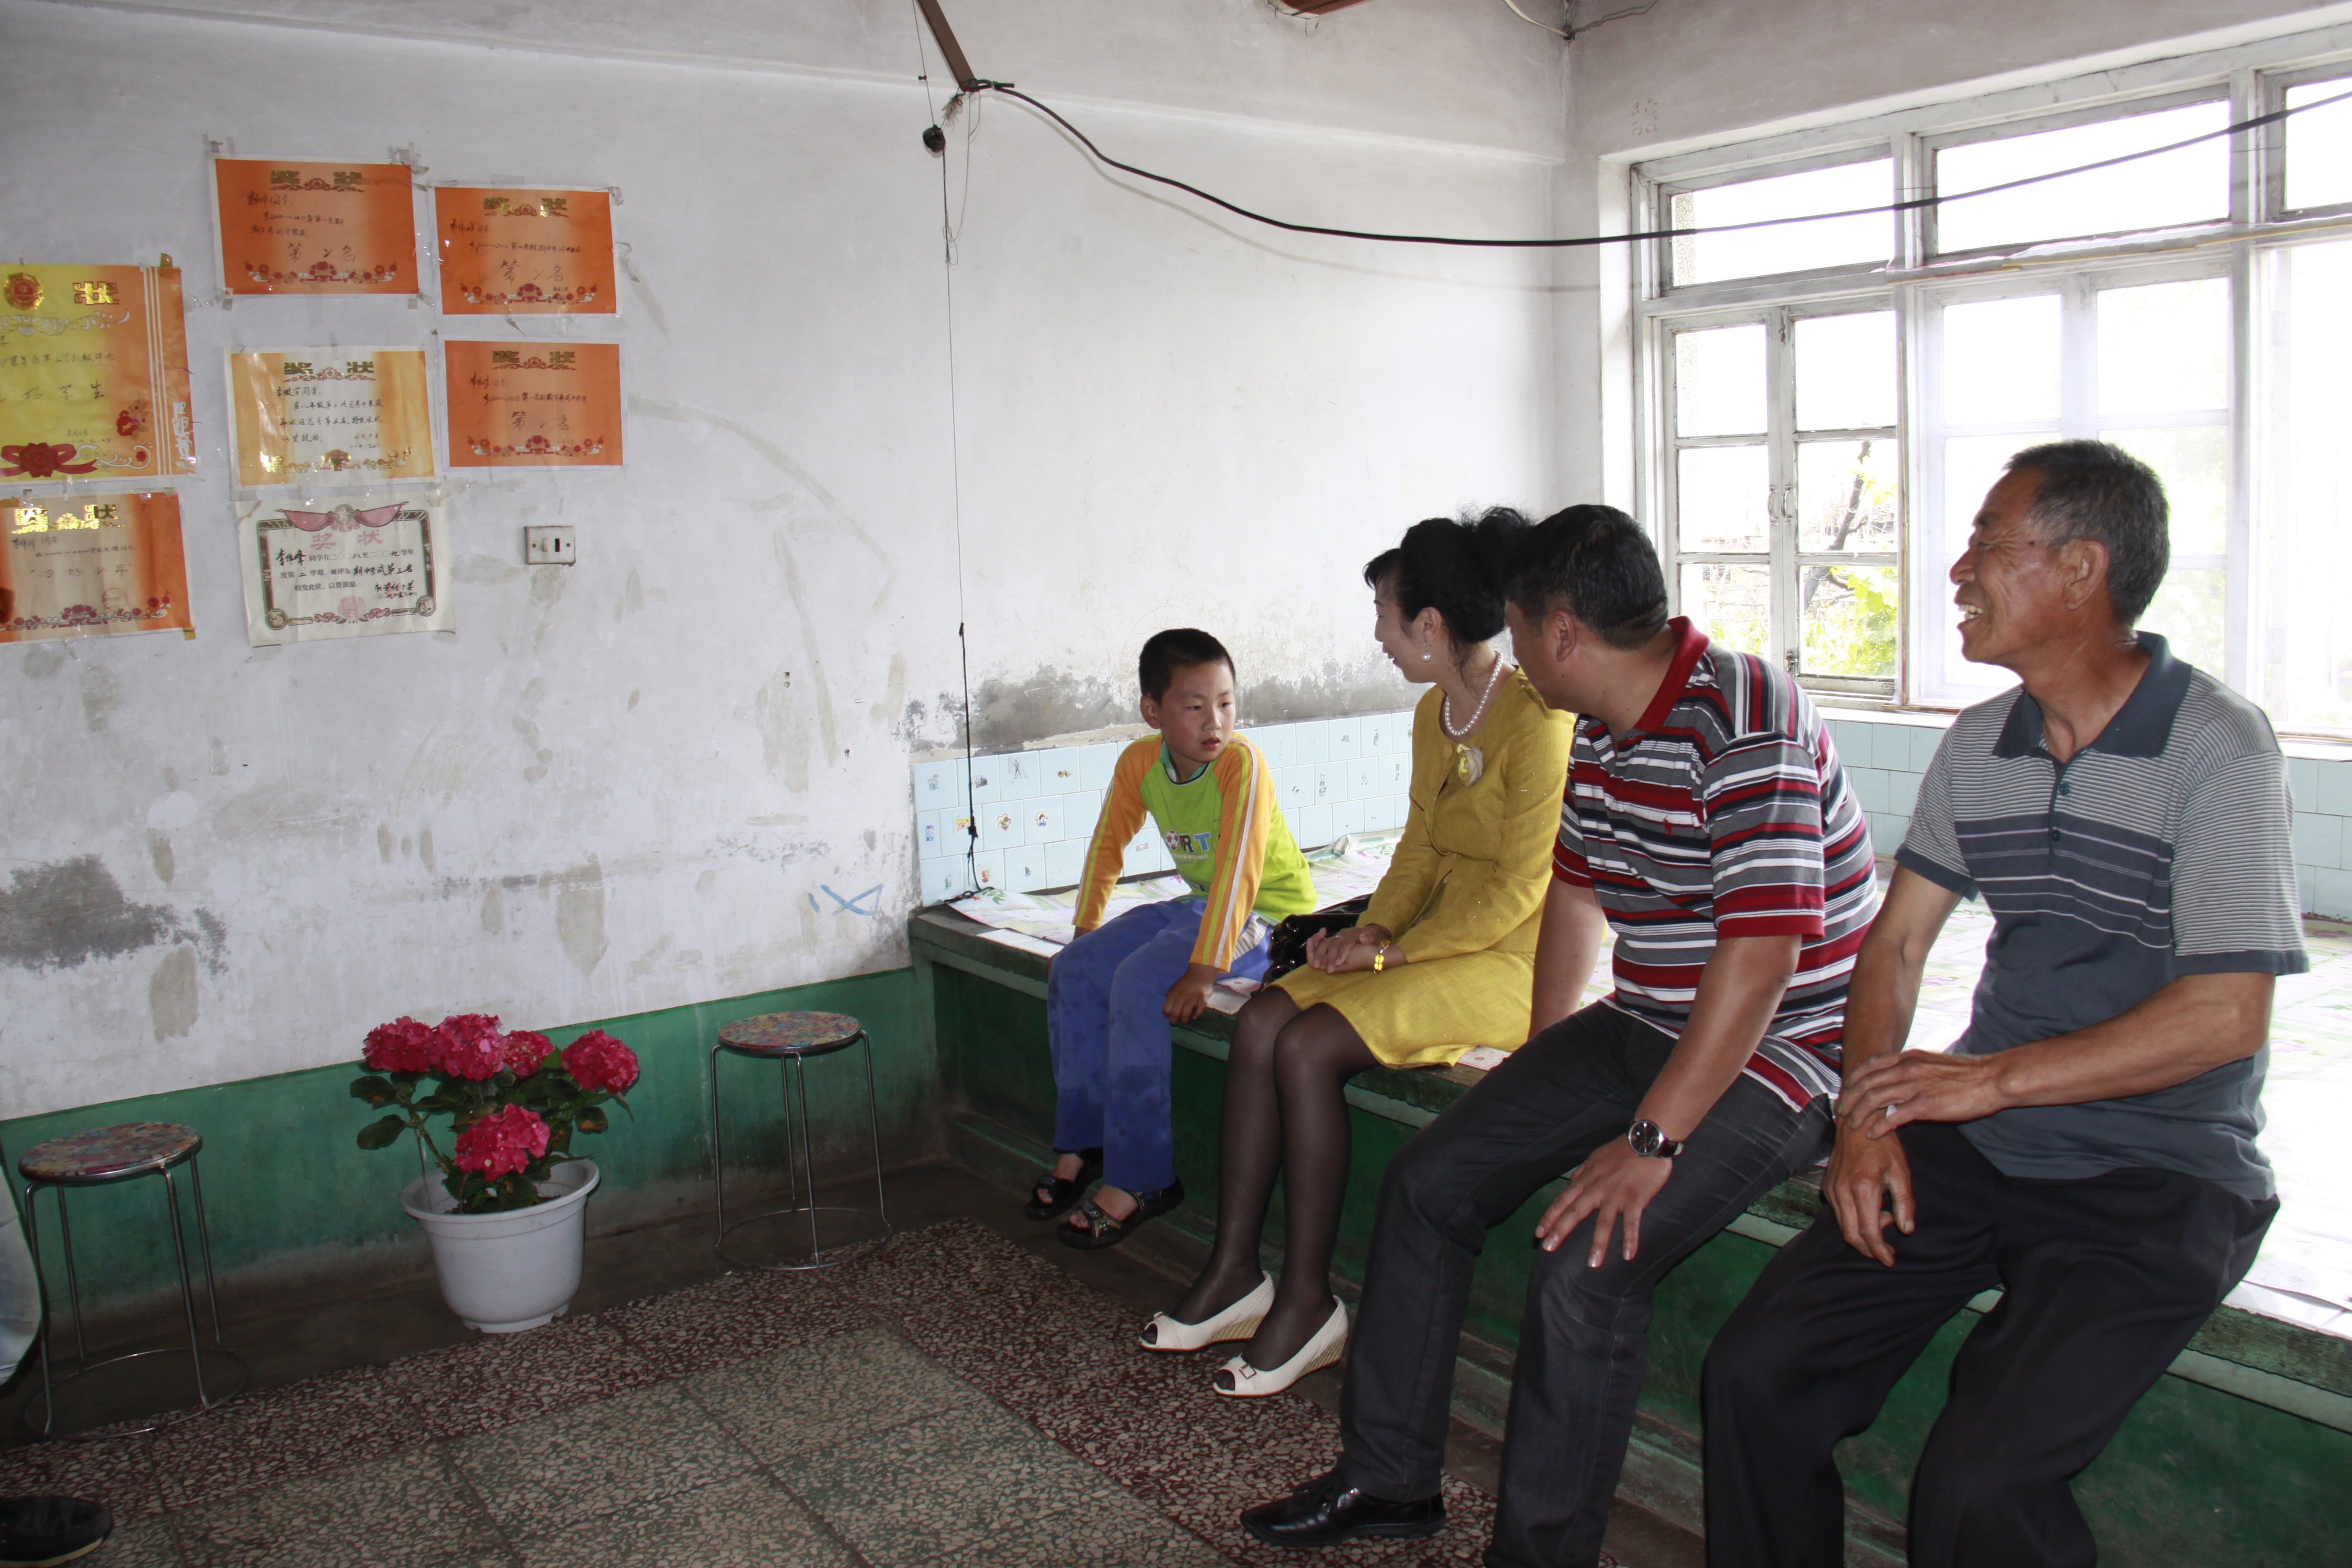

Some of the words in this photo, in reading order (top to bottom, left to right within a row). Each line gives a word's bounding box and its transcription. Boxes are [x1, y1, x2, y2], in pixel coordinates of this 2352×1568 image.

[73, 282, 119, 305] 状
[284, 361, 374, 375] 奖状
[310, 530, 383, 550] 奖状
